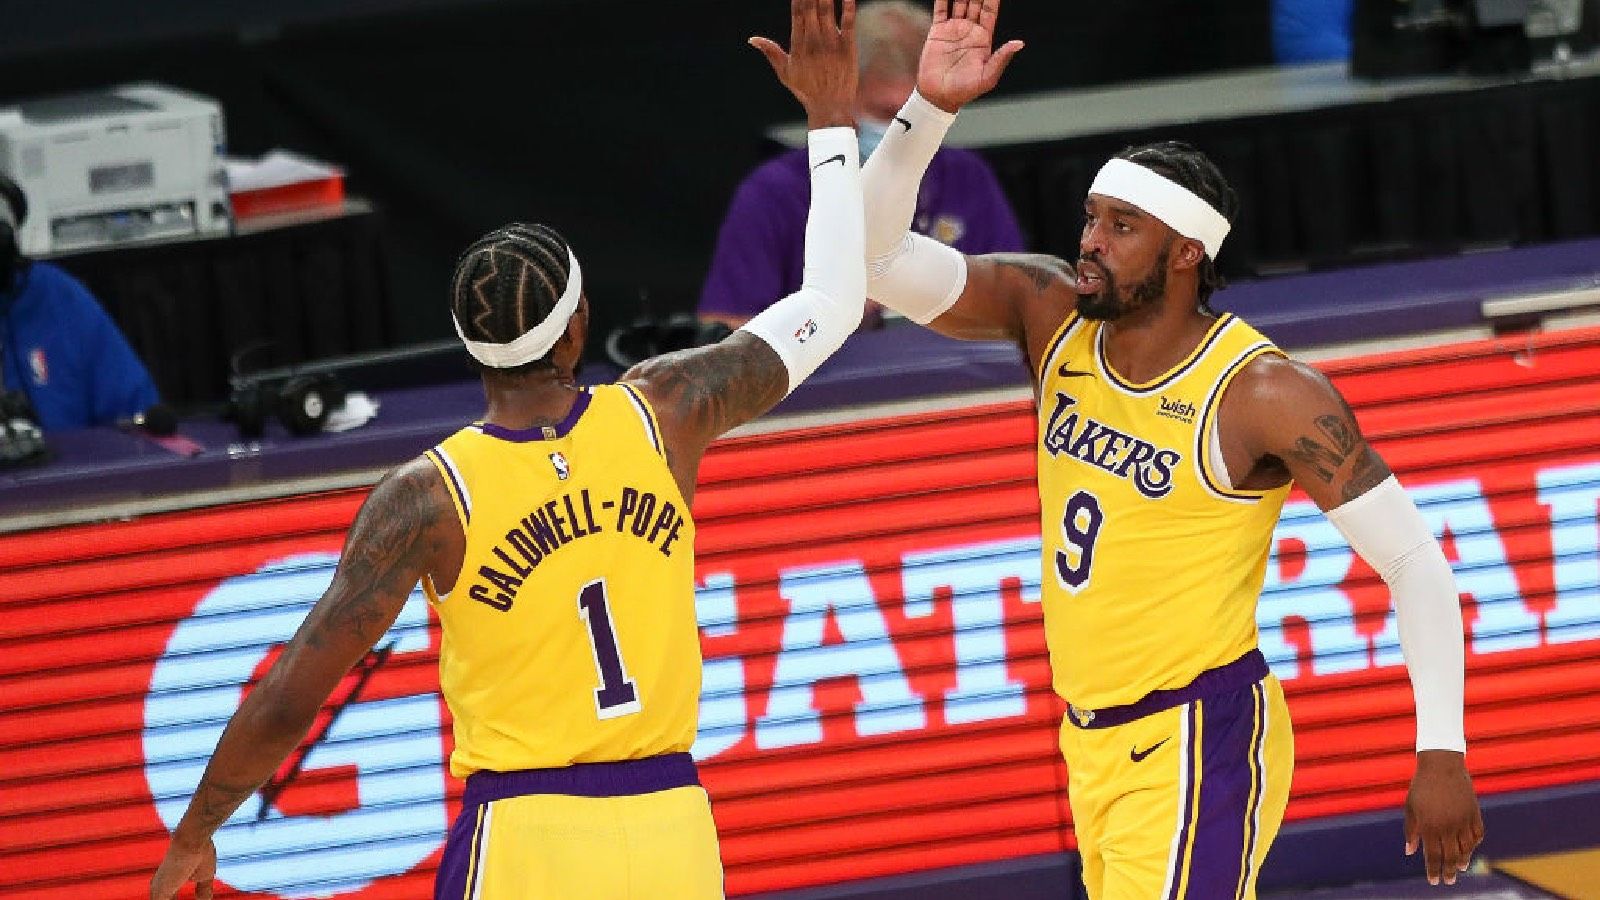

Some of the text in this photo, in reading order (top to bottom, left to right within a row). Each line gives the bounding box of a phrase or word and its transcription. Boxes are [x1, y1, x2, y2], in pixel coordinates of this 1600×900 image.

[1044, 392, 1182, 498] LAKERS
[1160, 395, 1196, 418] wish
[469, 487, 684, 613] CALDWELL-POPE
[1055, 488, 1105, 596] 9
[577, 576, 642, 720] 1
